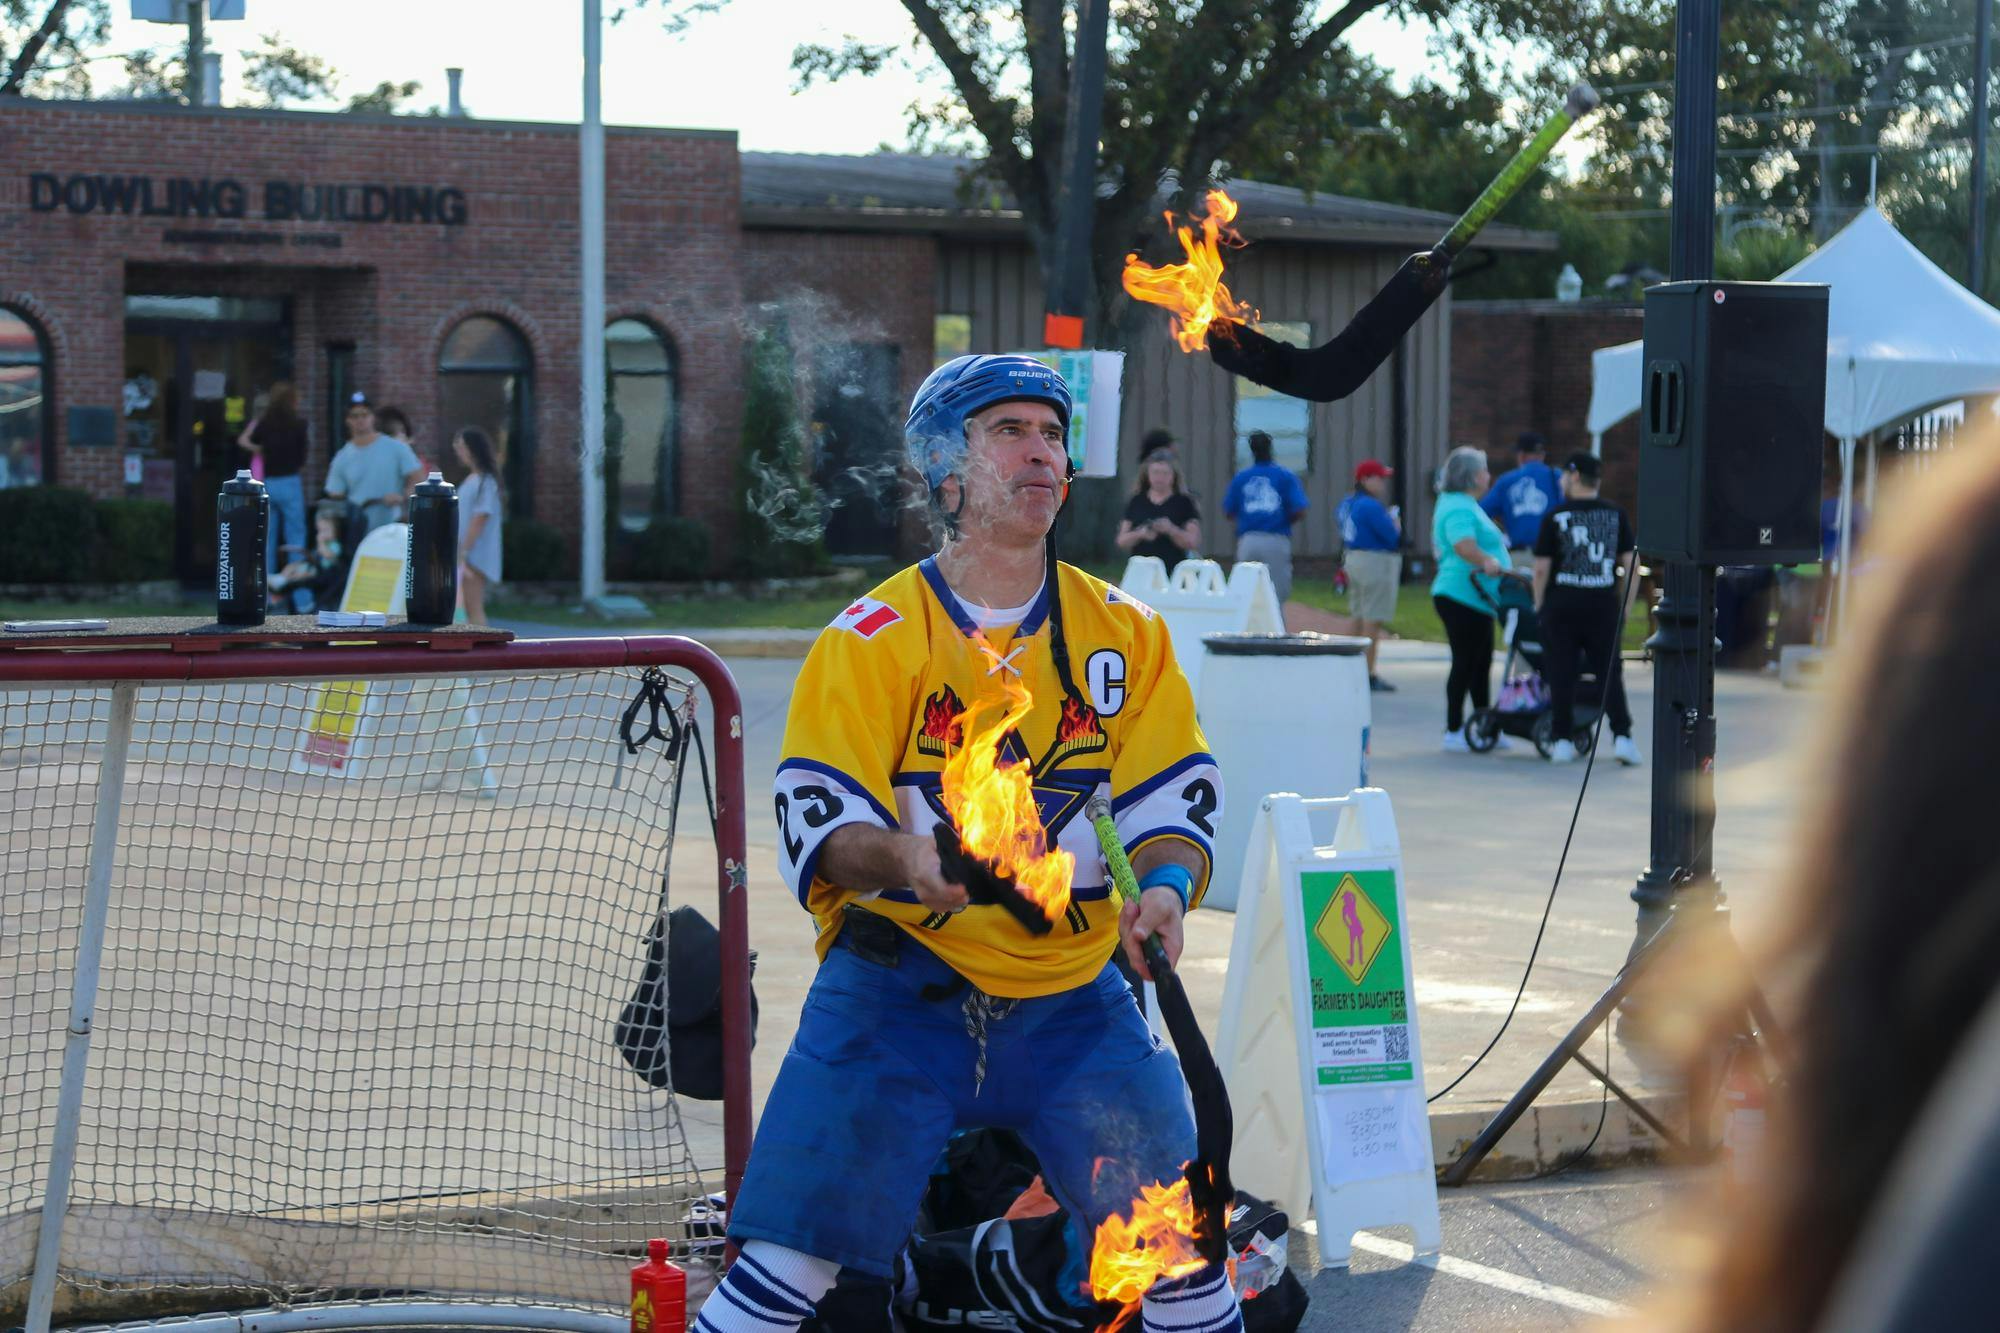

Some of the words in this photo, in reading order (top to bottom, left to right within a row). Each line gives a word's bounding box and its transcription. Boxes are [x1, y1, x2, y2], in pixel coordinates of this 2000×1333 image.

[31, 173, 246, 217] DOWLING
[265, 179, 467, 226] BUILDING
[1008, 369, 1051, 380] BAUER
[219, 522, 230, 600] BODYARMOR
[1085, 648, 1126, 718] C
[774, 785, 845, 869] 23
[1181, 778, 1216, 838] 2
[1311, 978, 1323, 992] THE
[1313, 992, 1356, 1010] FARMER'S
[1358, 990, 1406, 1009] DAUGHTER
